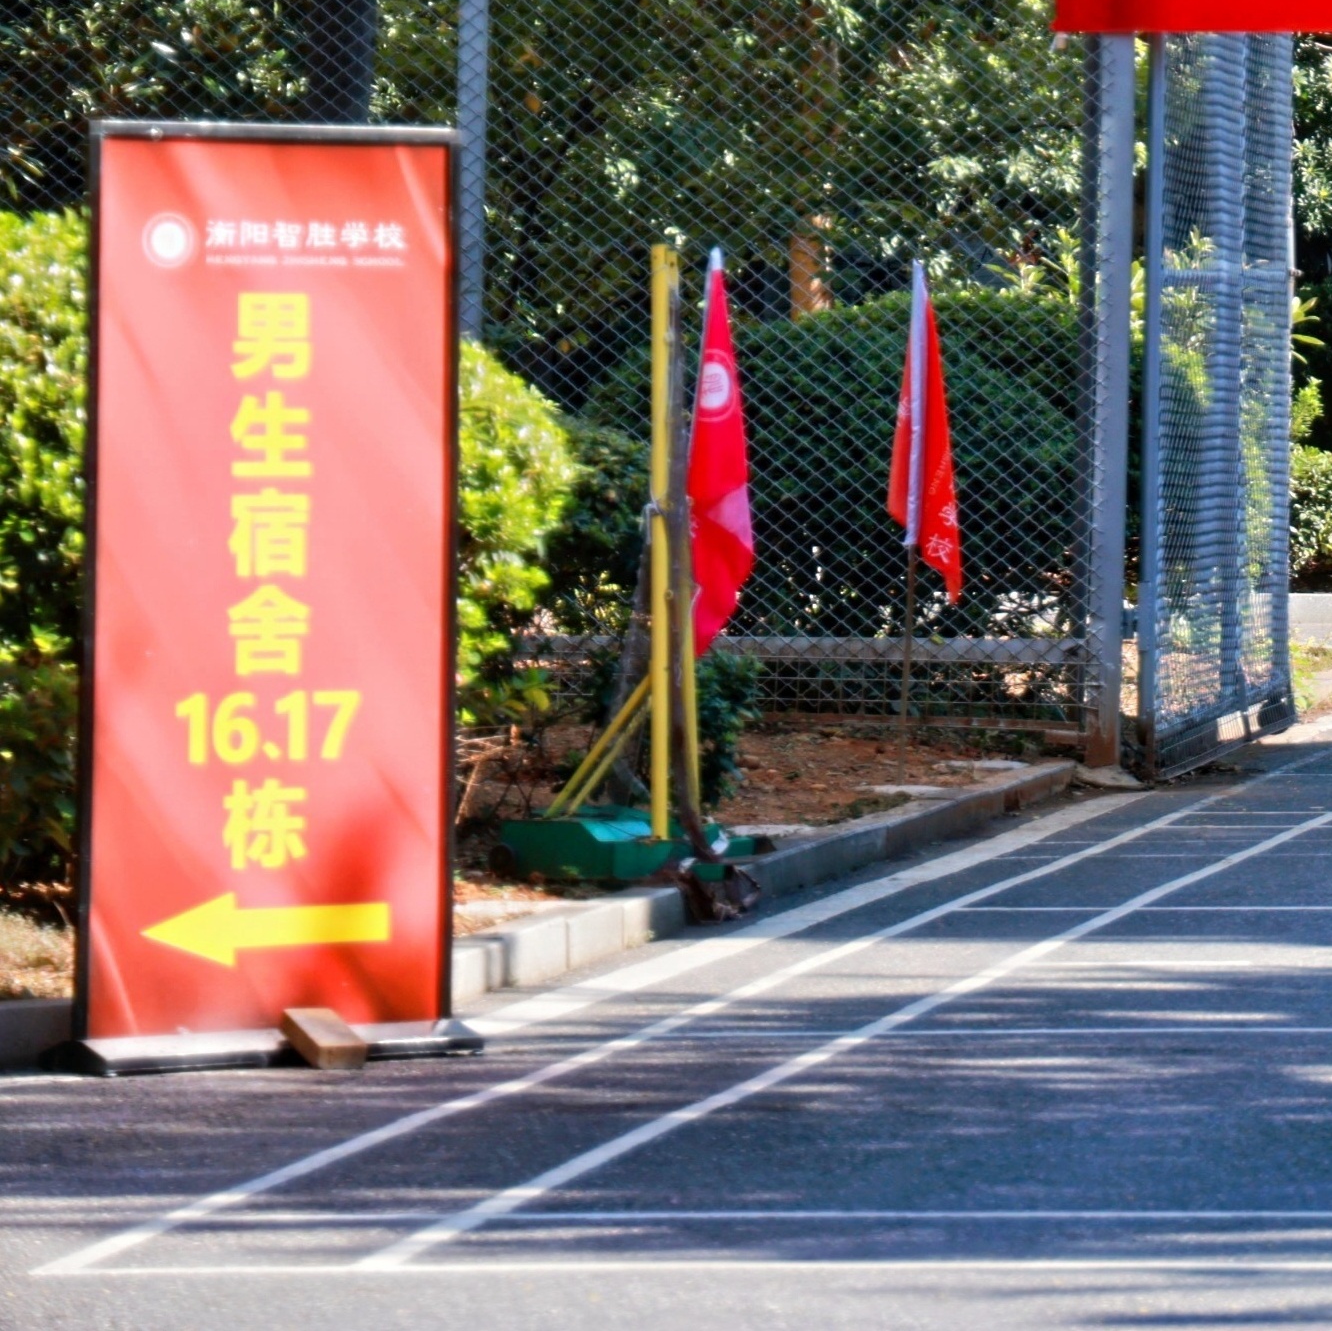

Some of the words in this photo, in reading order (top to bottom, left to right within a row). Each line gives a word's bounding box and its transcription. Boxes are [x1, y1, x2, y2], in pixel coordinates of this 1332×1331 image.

[228, 291, 313, 677] 男生宿舍
[222, 778, 308, 870] 栋
